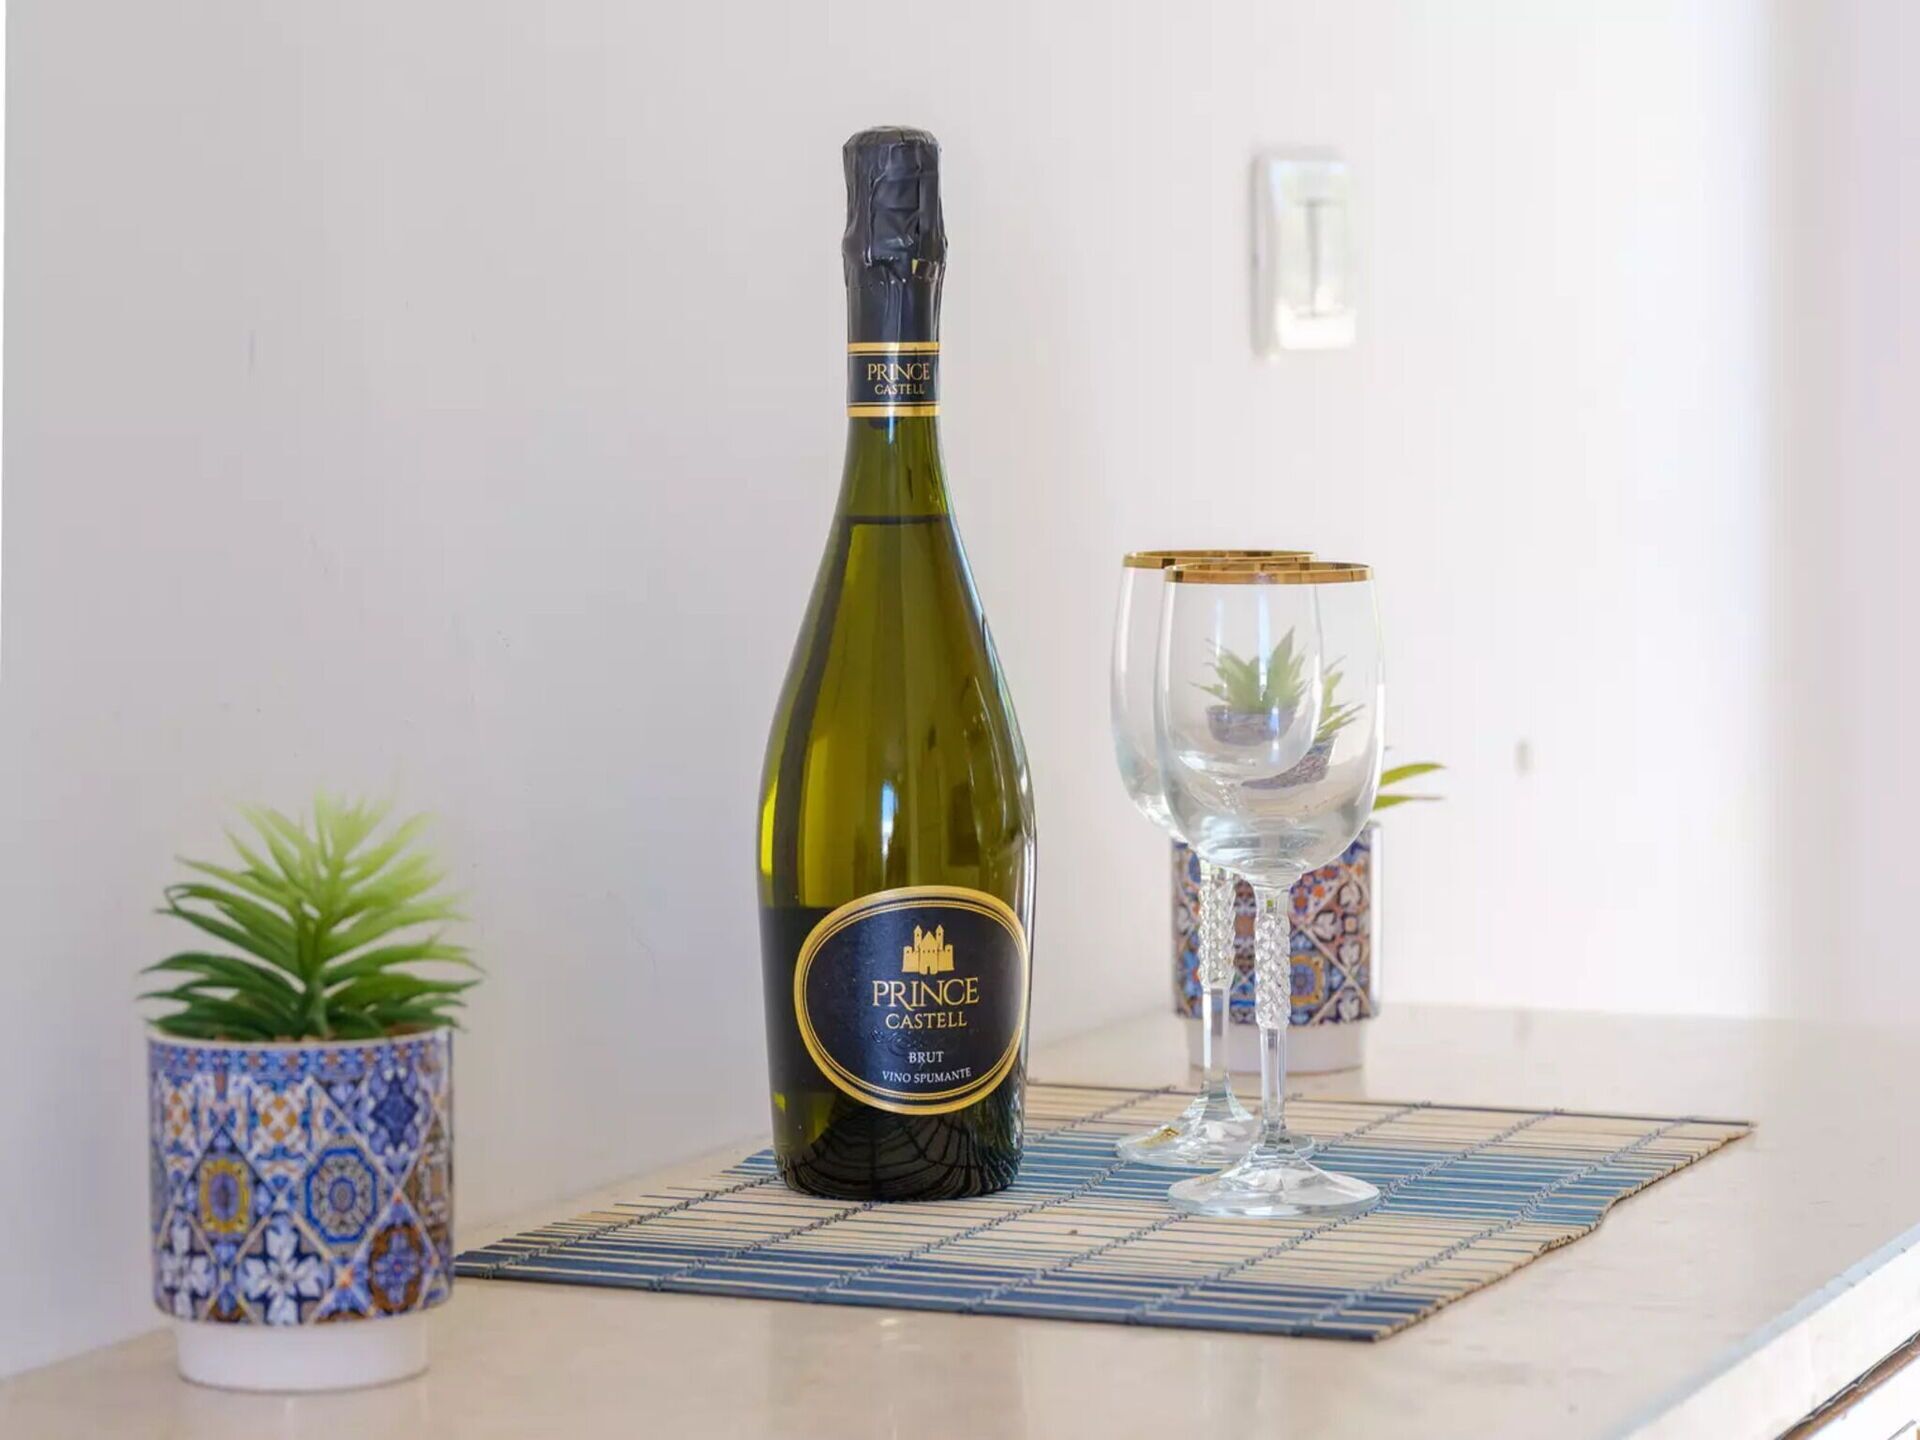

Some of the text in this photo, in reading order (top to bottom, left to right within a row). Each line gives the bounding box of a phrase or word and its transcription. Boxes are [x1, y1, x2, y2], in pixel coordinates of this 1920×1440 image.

[867, 363, 931, 384] PRINCE
[874, 384, 926, 395] CASTELL
[872, 977, 980, 1011] PRINCE
[885, 1011, 968, 1030] CASTELL
[909, 1051, 945, 1065] BRUT
[882, 1067, 972, 1085] VINO SPUMANTE
